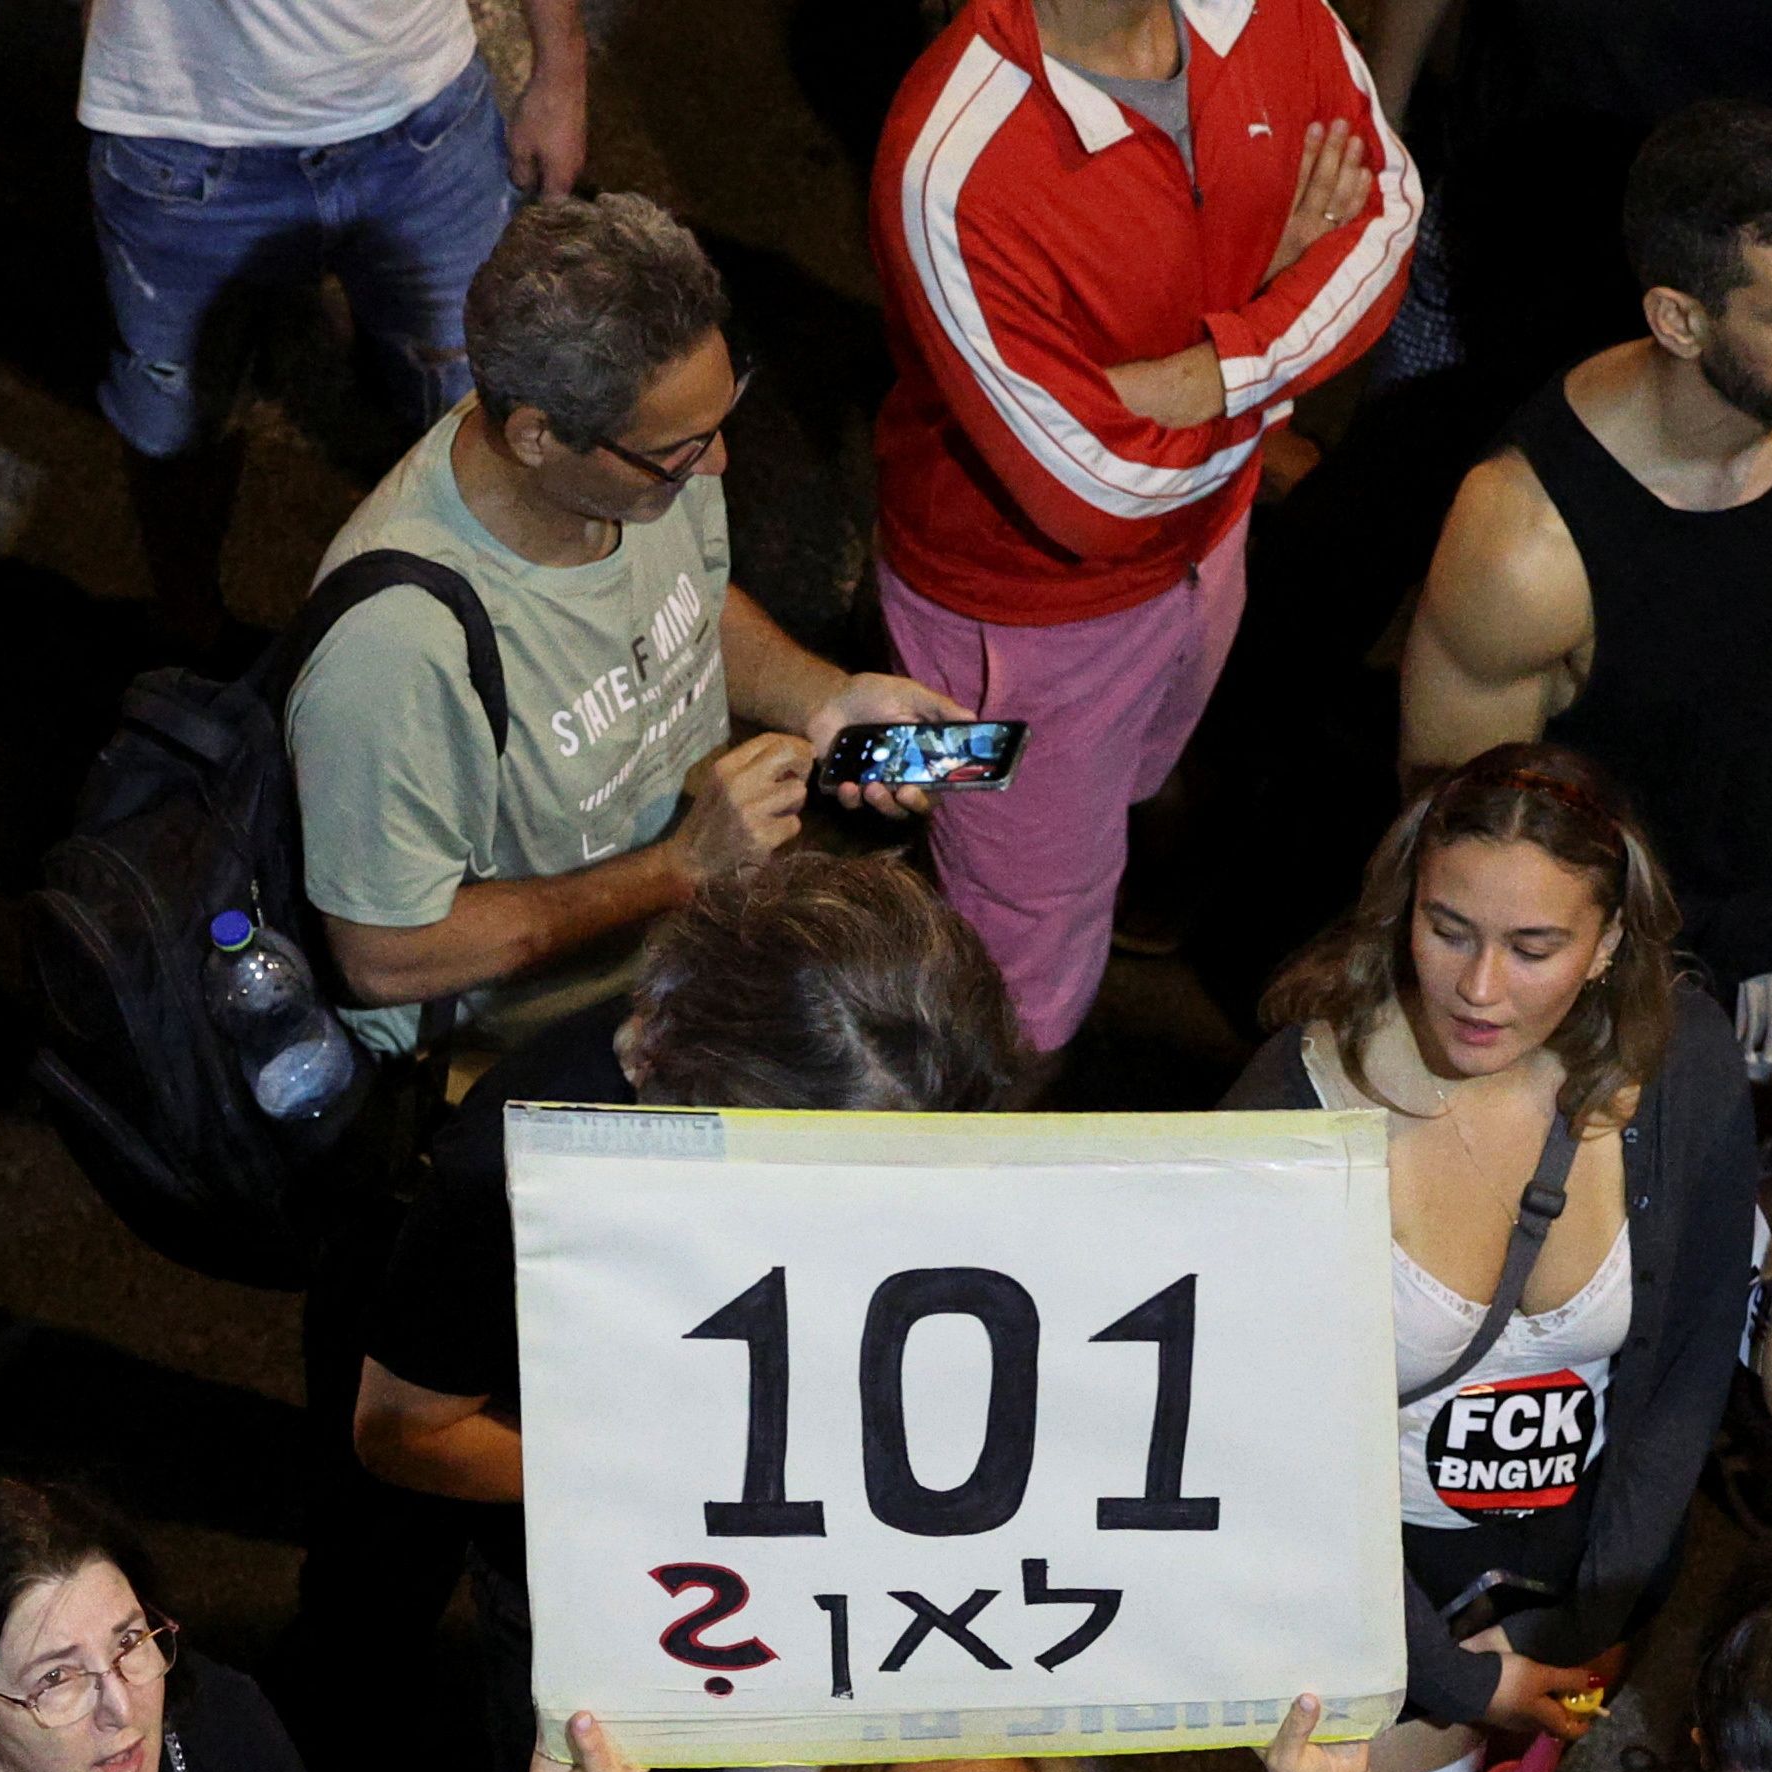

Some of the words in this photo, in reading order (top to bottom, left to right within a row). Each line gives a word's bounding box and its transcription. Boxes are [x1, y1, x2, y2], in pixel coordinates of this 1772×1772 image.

[551, 666, 636, 757] STATE
[631, 635, 649, 687] F
[682, 1265, 1221, 1537] 101
[1446, 1390, 1588, 1451] FCK
[1436, 1452, 1577, 1491] BNGVR
